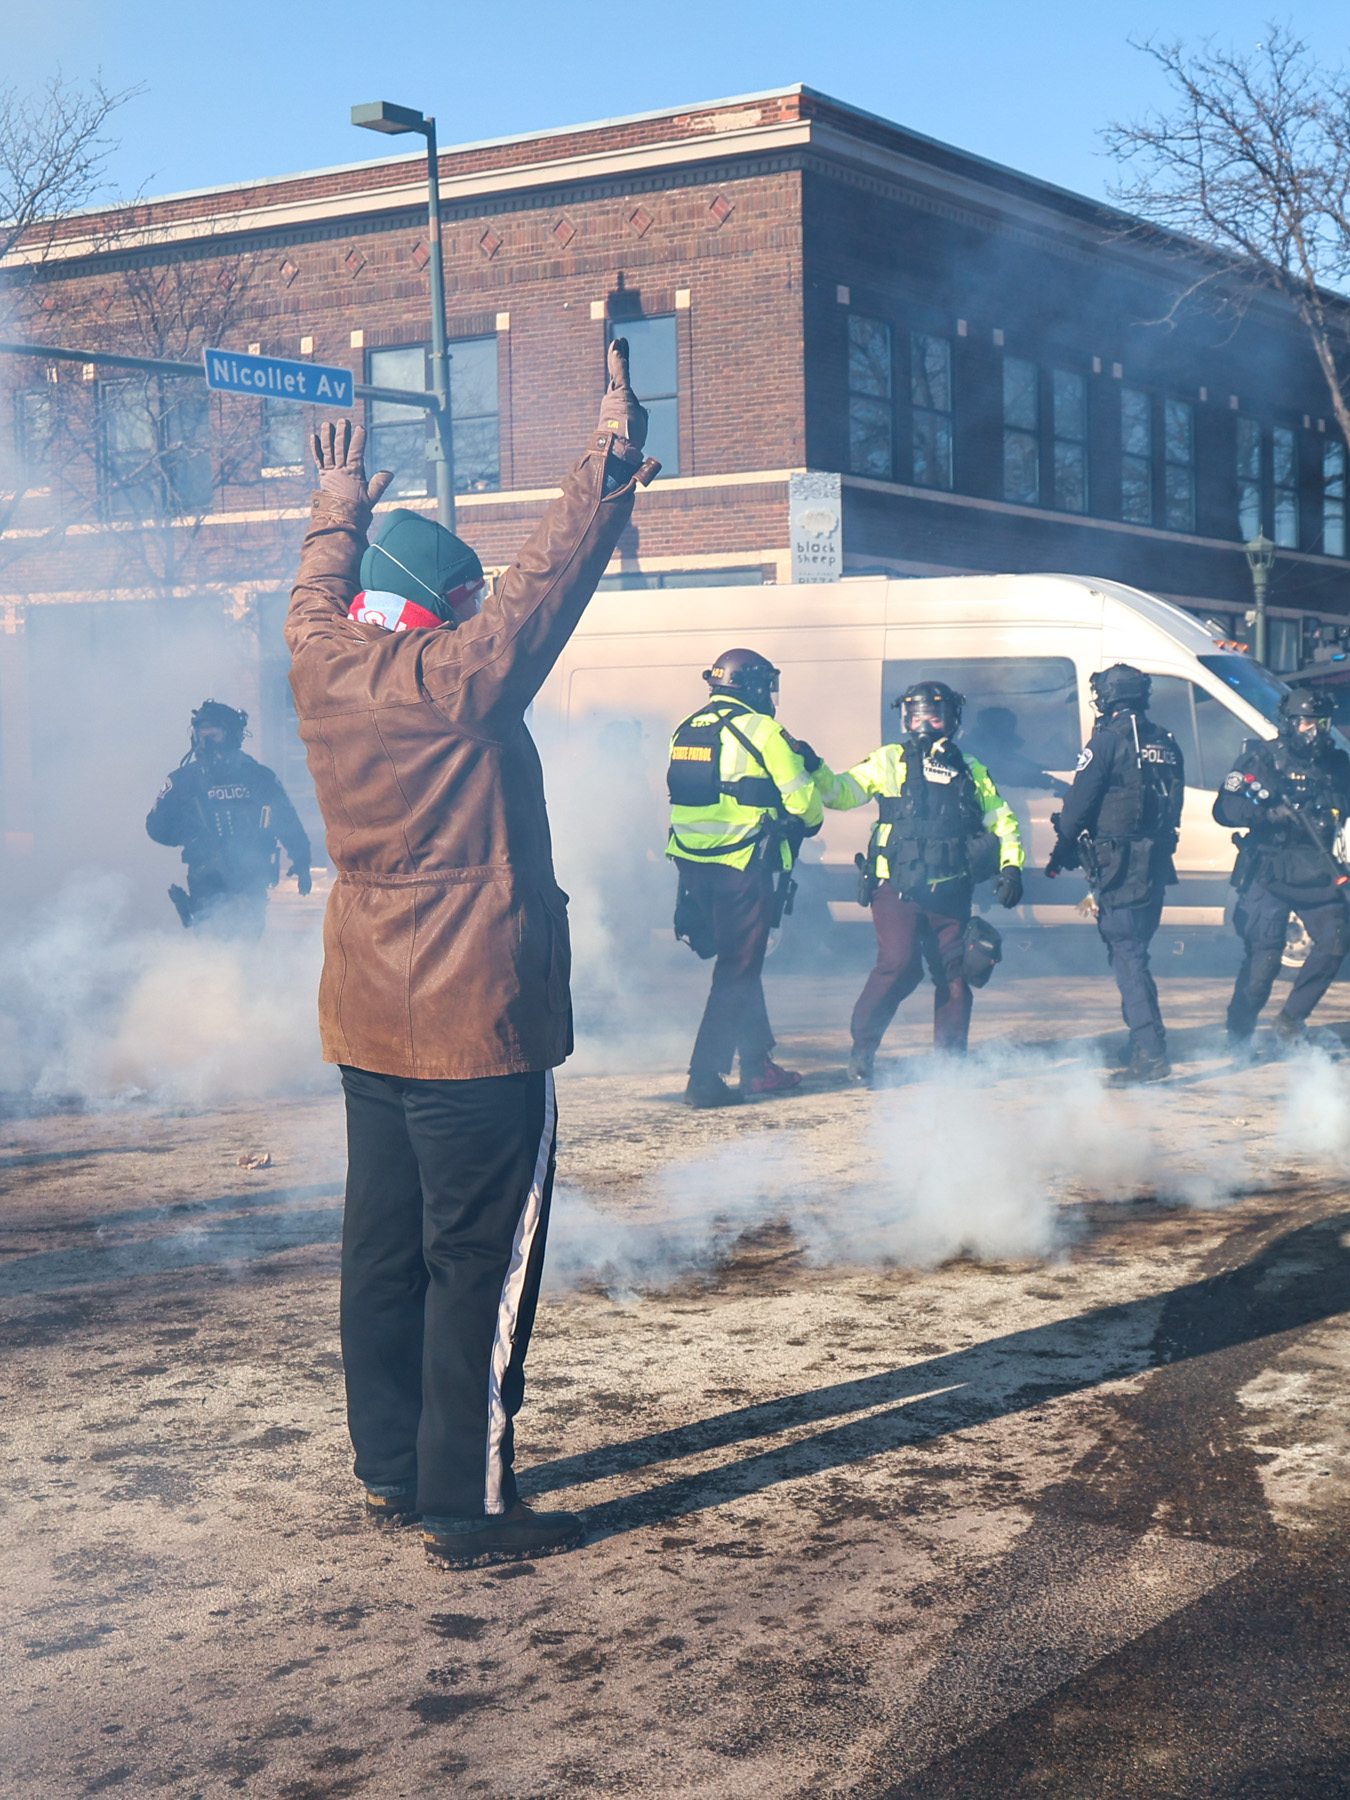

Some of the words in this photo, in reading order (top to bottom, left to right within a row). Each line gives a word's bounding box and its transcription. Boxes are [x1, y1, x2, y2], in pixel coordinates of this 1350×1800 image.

[213, 358, 306, 393] Nicollet
[316, 374, 346, 399] Av
[689, 746, 712, 762] PATROL
[1141, 749, 1177, 765] POLICE
